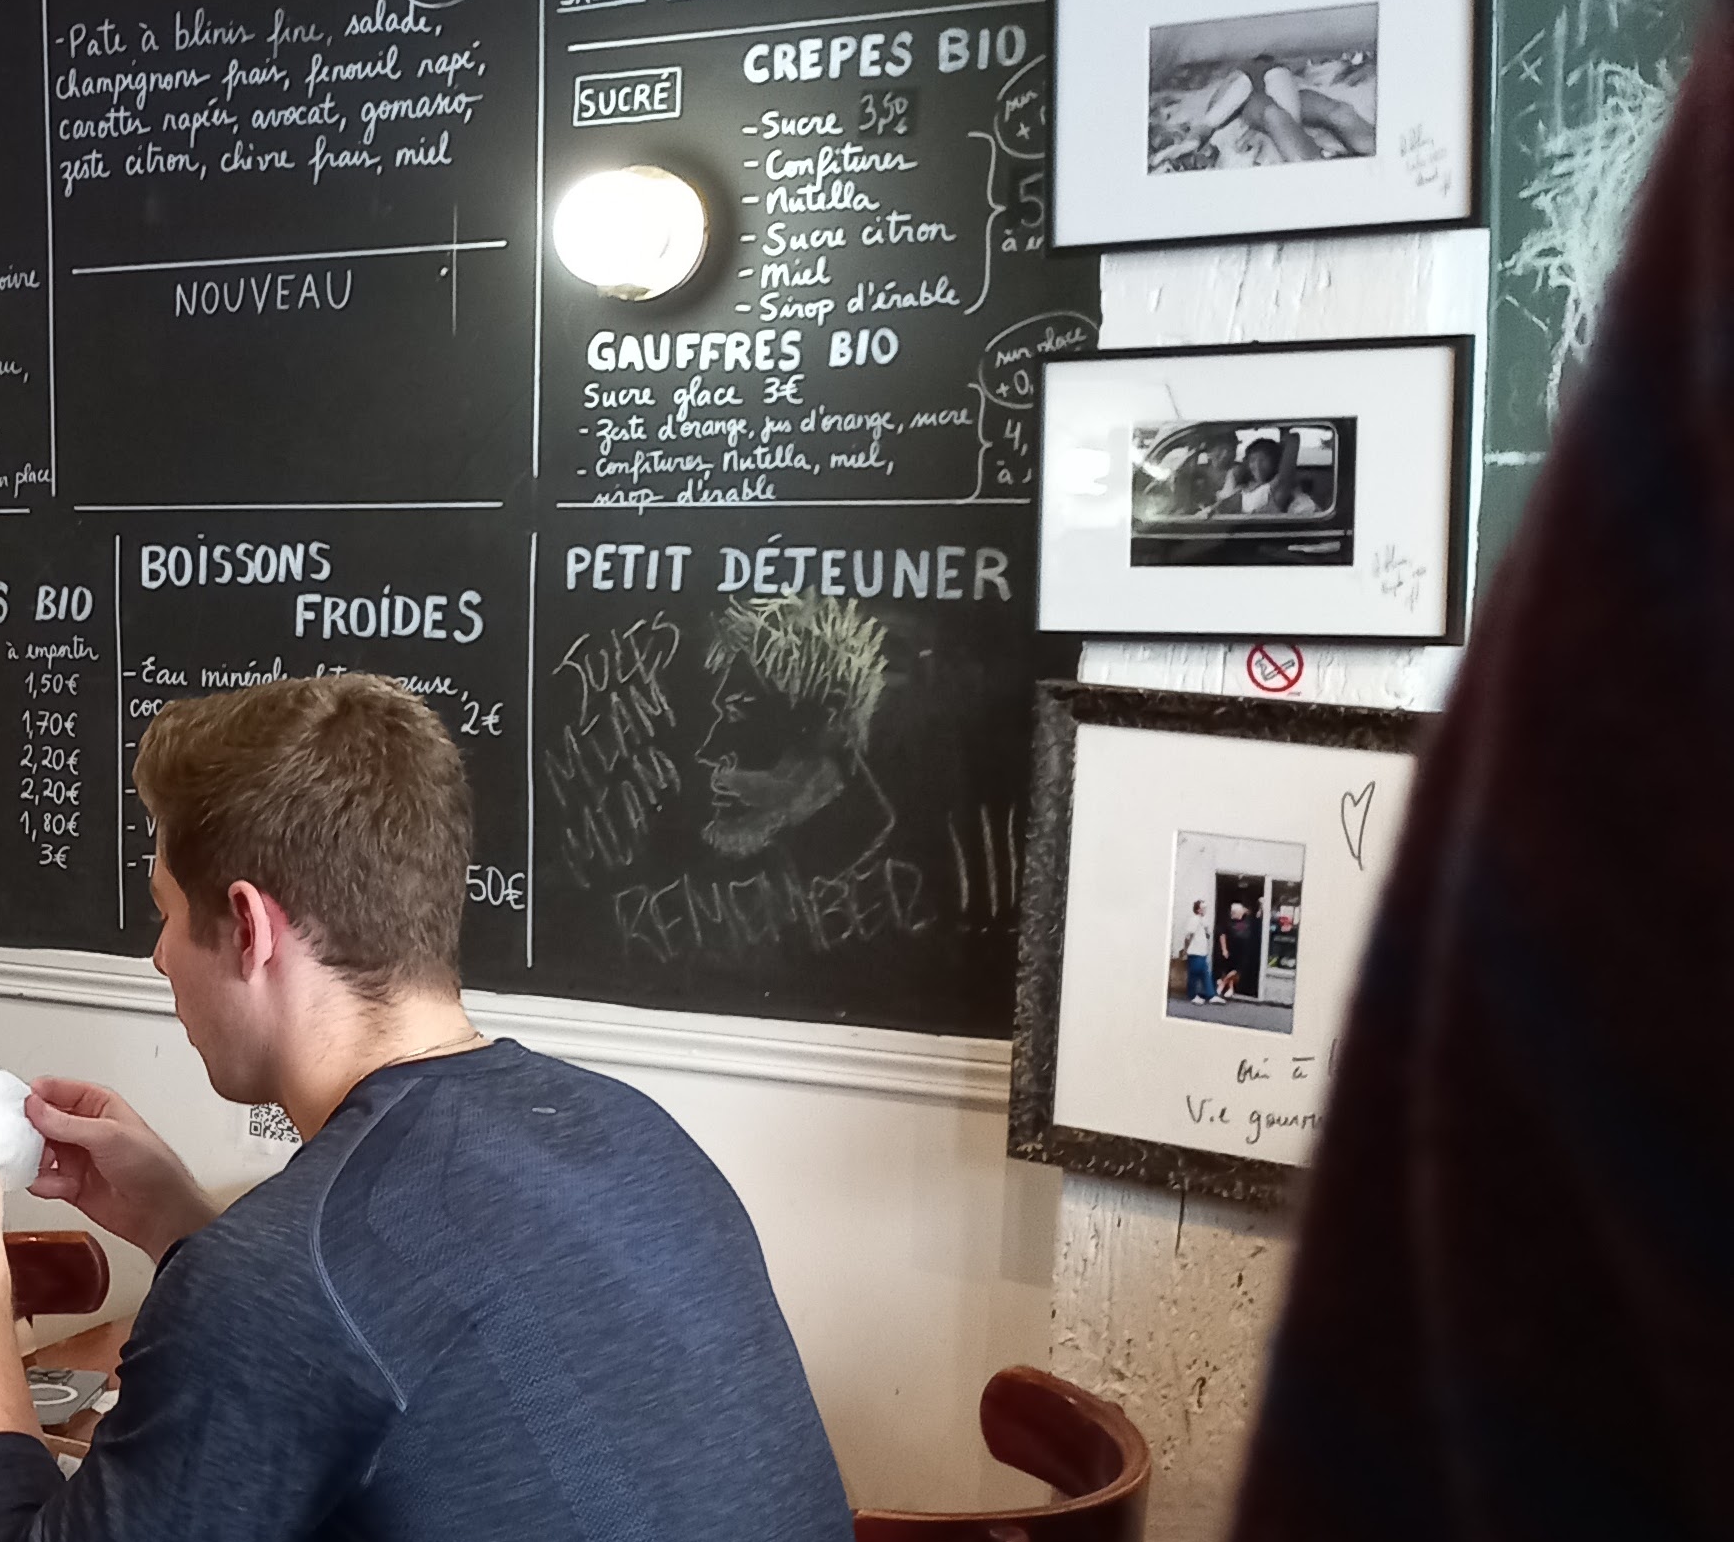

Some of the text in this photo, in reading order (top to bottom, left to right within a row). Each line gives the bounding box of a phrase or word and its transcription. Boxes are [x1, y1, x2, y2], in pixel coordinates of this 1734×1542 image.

[744, 26, 1025, 83] CREPES BIO
[579, 73, 672, 117] SUCRÉ
[176, 270, 351, 316] NOUVEAU
[588, 328, 898, 371] GAUFFRES BIO
[142, 534, 330, 589] BOISSONS
[567, 532, 1013, 602] PETIT DÉJEUNER
[36, 586, 92, 621] BIO
[296, 585, 483, 643] FROIDES
